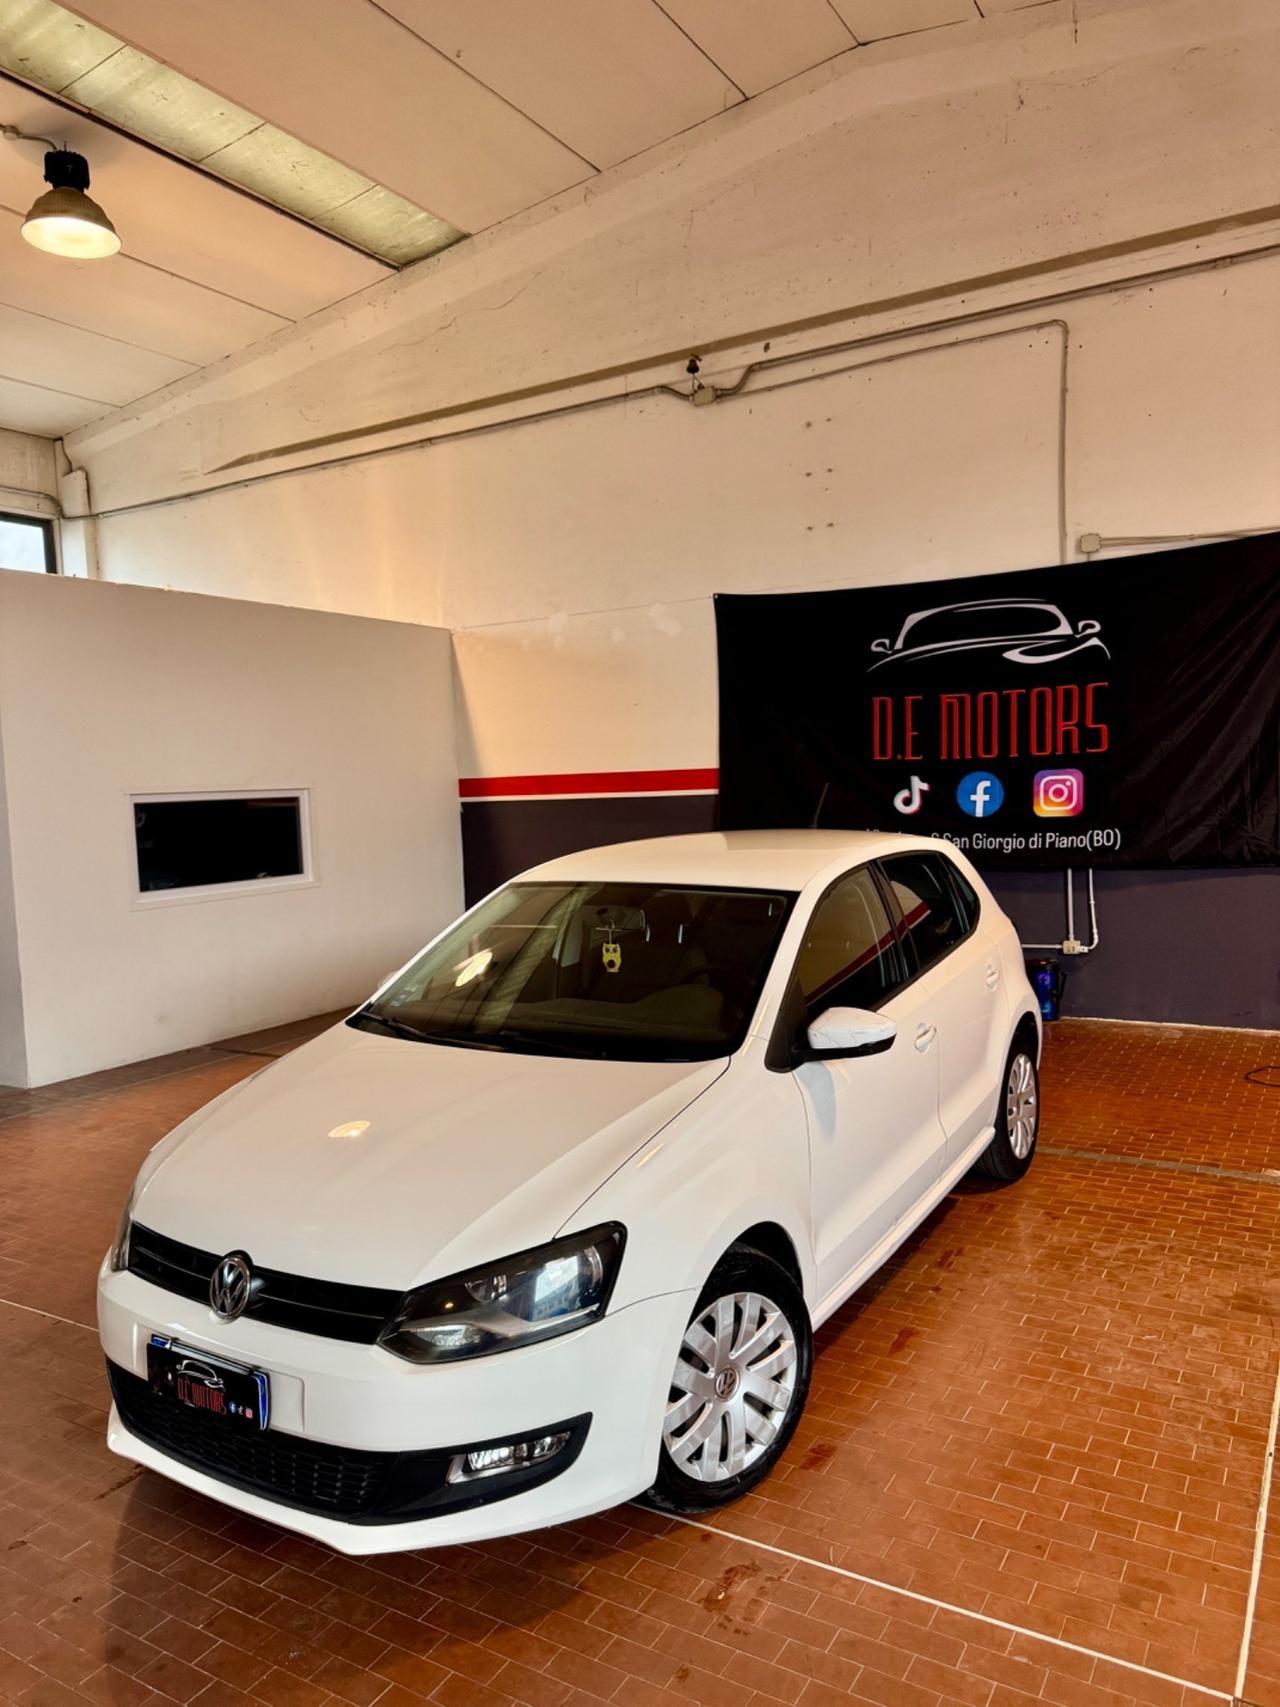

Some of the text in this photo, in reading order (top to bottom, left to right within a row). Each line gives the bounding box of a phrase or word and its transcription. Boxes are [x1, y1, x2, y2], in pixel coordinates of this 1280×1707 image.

[872, 681, 1108, 760] D.E MOTORS
[972, 832, 1025, 853] Giorgio
[1029, 832, 1043, 849] di
[1045, 828, 1121, 852] Piano(BO)
